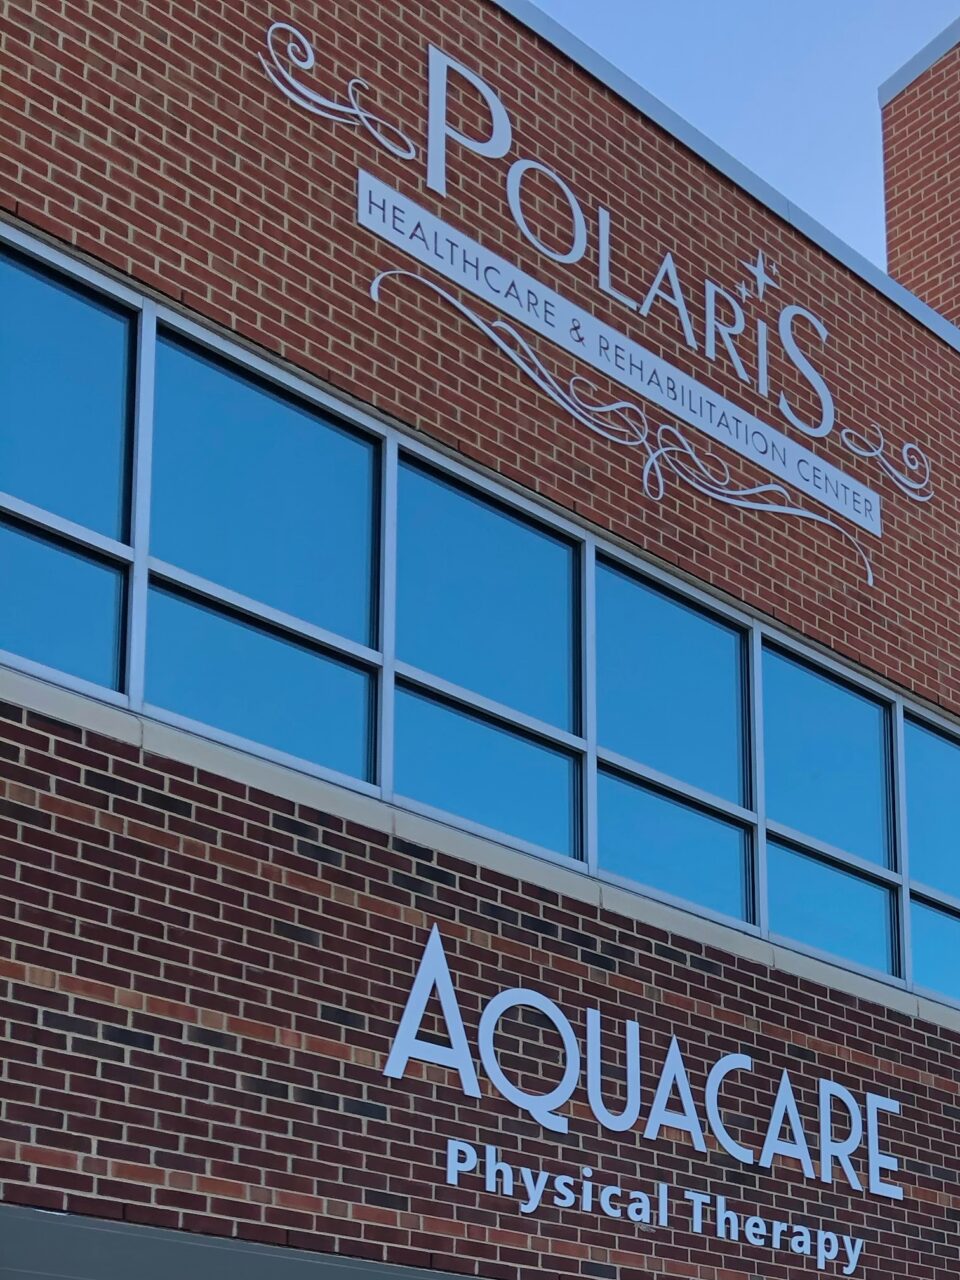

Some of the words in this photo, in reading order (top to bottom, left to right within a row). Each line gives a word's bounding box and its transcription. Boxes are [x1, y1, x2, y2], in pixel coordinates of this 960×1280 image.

[367, 189, 557, 329] HEALTHCARE
[568, 318, 587, 348] &
[597, 334, 787, 468] REHABILITATION
[796, 458, 875, 523] CENTER
[426, 43, 835, 438] POLARIS
[382, 922, 905, 1201] AQUACARE
[445, 1138, 669, 1228] Physical
[683, 1190, 865, 1275] Therapy
